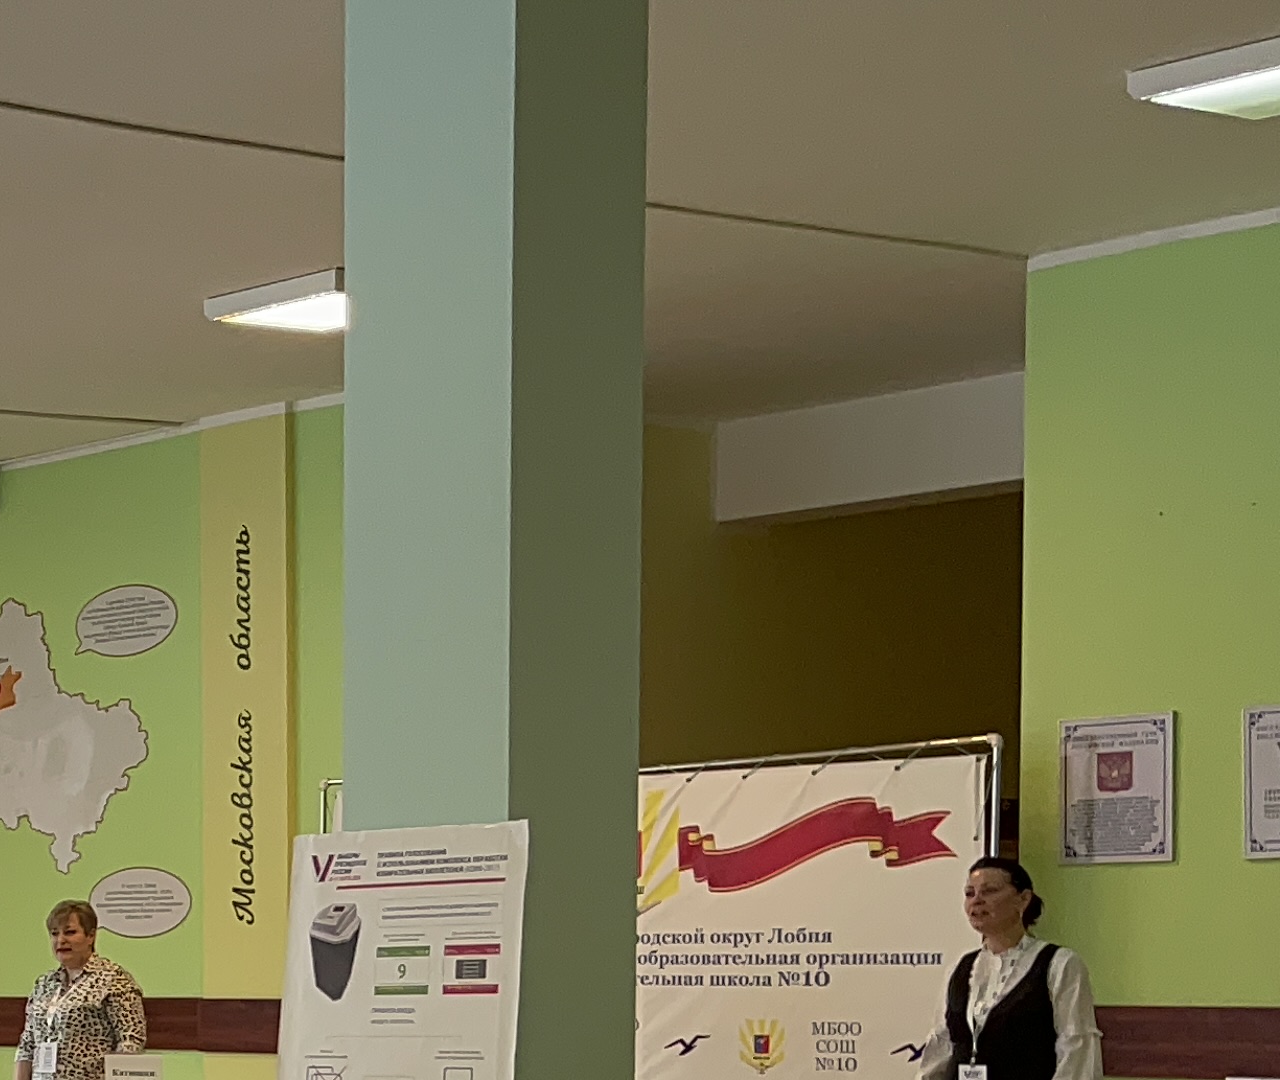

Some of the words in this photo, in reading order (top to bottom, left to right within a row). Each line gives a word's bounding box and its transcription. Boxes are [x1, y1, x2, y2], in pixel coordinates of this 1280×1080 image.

[229, 524, 252, 671] область
[230, 709, 256, 926] Московская
[710, 931, 764, 948] округ
[767, 928, 832, 944] Лобня
[638, 951, 800, 968] образовательная
[806, 952, 943, 969] организация
[396, 963, 407, 979] 9
[636, 973, 704, 987] ельная
[710, 972, 772, 987] школа
[777, 970, 831, 987] №10
[811, 1021, 862, 1036] МБОО
[815, 1039, 856, 1054] СОШ
[815, 1057, 858, 1072] №10
